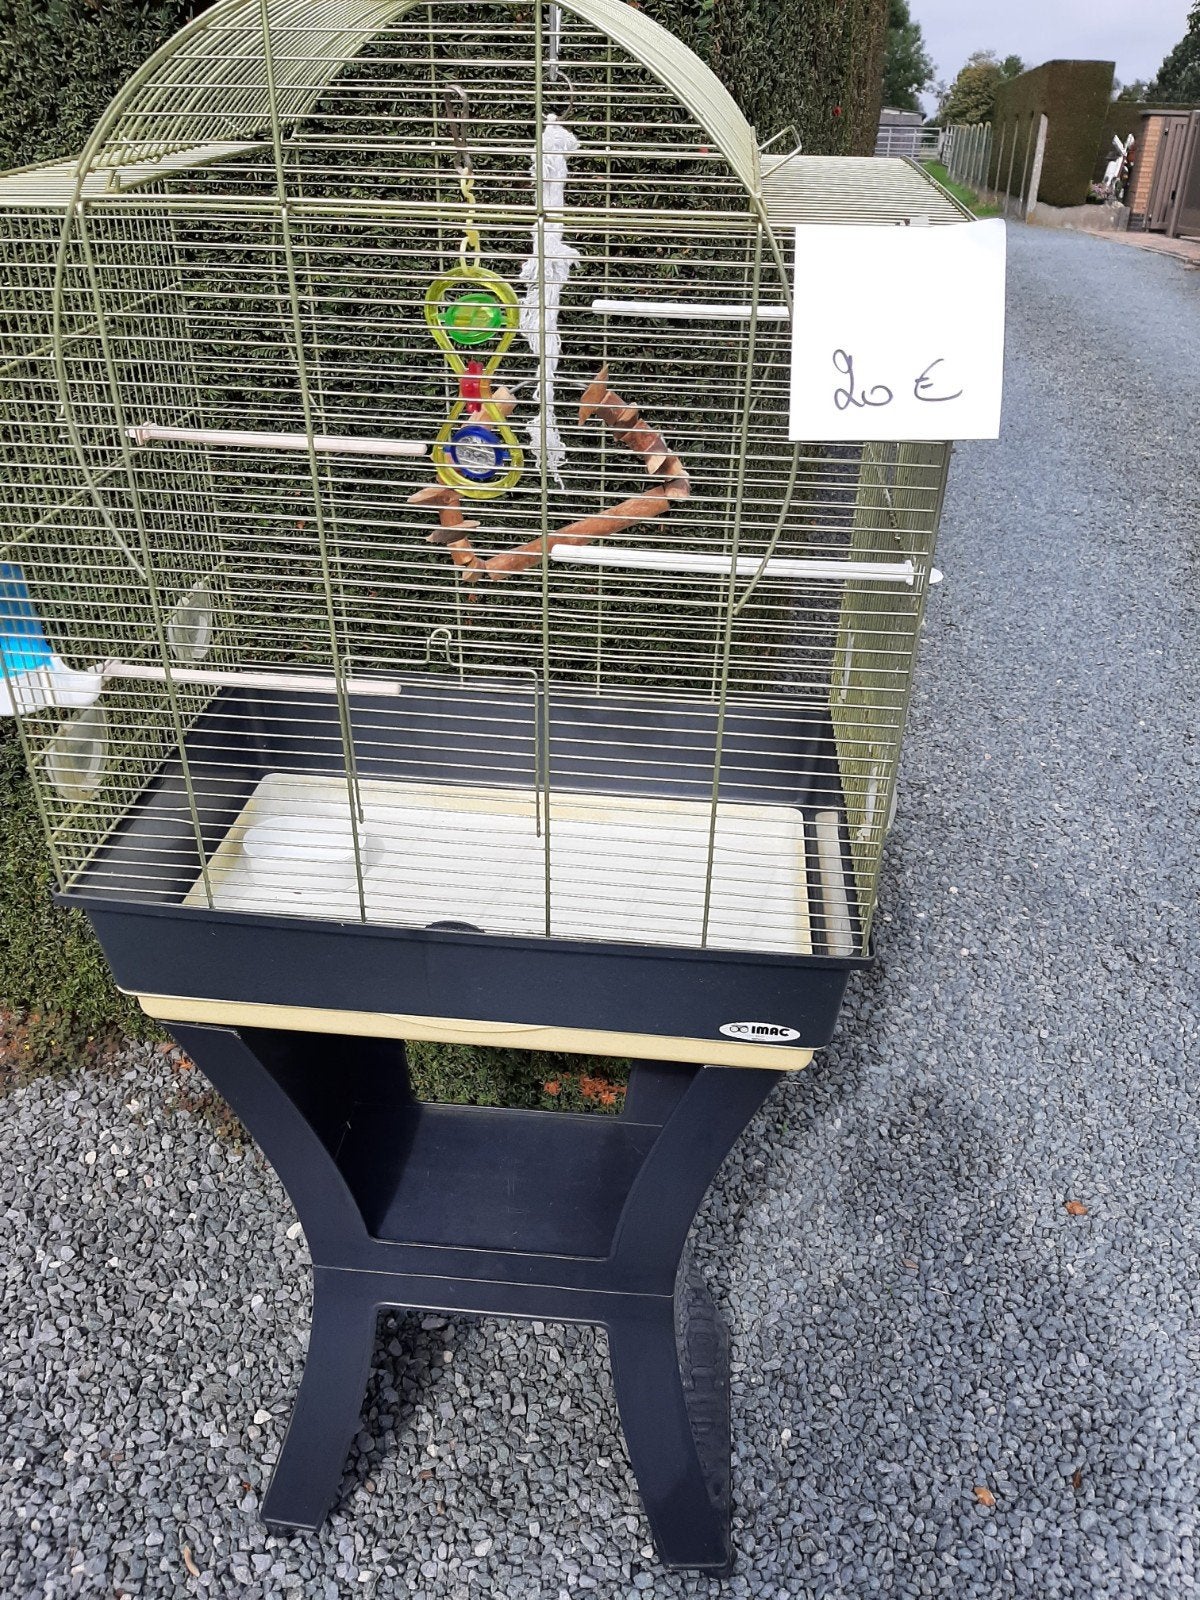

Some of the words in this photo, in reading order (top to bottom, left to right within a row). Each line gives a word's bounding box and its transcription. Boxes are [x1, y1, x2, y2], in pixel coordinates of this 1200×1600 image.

[832, 349, 893, 410] 20
[914, 358, 963, 402] €
[751, 1025, 790, 1037] IMAC
